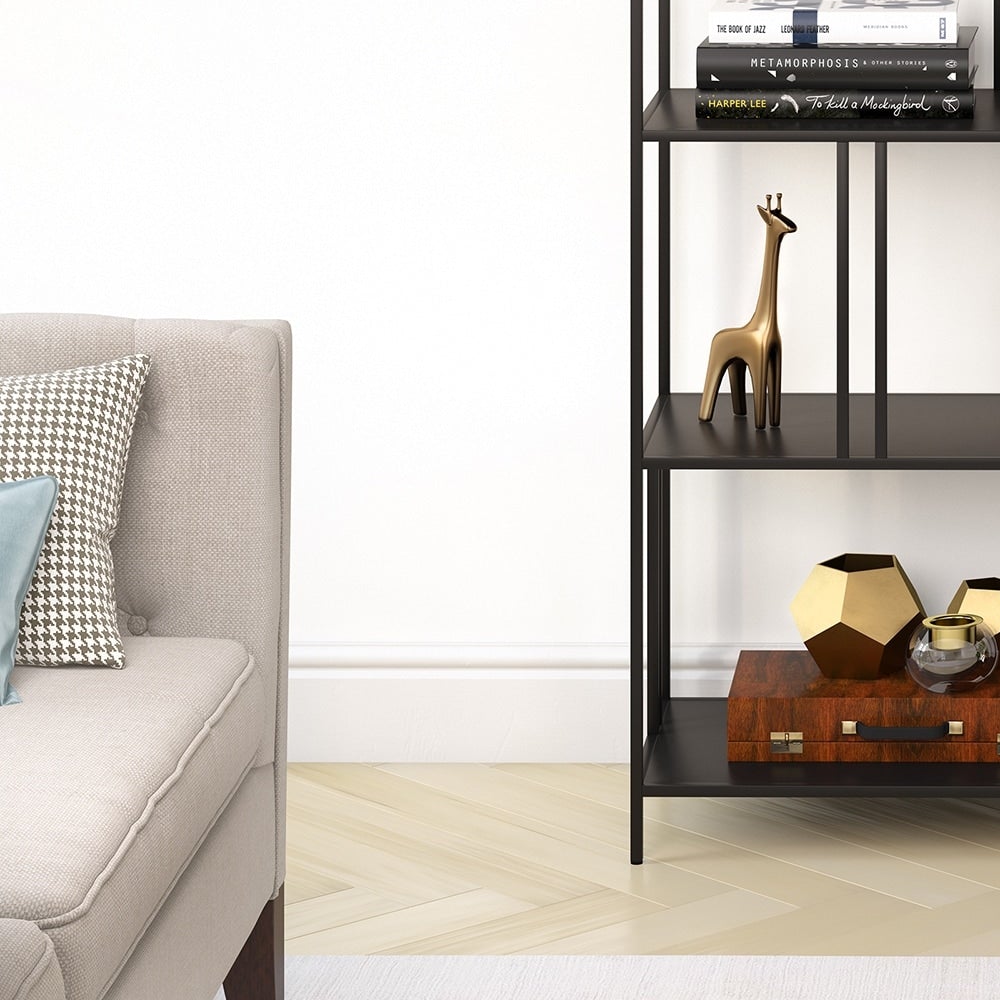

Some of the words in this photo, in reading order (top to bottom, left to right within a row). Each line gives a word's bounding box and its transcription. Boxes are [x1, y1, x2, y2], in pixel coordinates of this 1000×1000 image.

[717, 24, 727, 34] THE
[728, 24, 743, 34] BOOK
[744, 24, 752, 34] OF
[753, 24, 766, 34] JAZZ
[750, 58, 859, 68] METAMORPHOSIS
[708, 99, 747, 108] HARPER
[750, 99, 767, 108] LEE
[805, 95, 830, 109] To
[851, 101, 858, 109] a
[860, 94, 931, 117] Mockingbird
